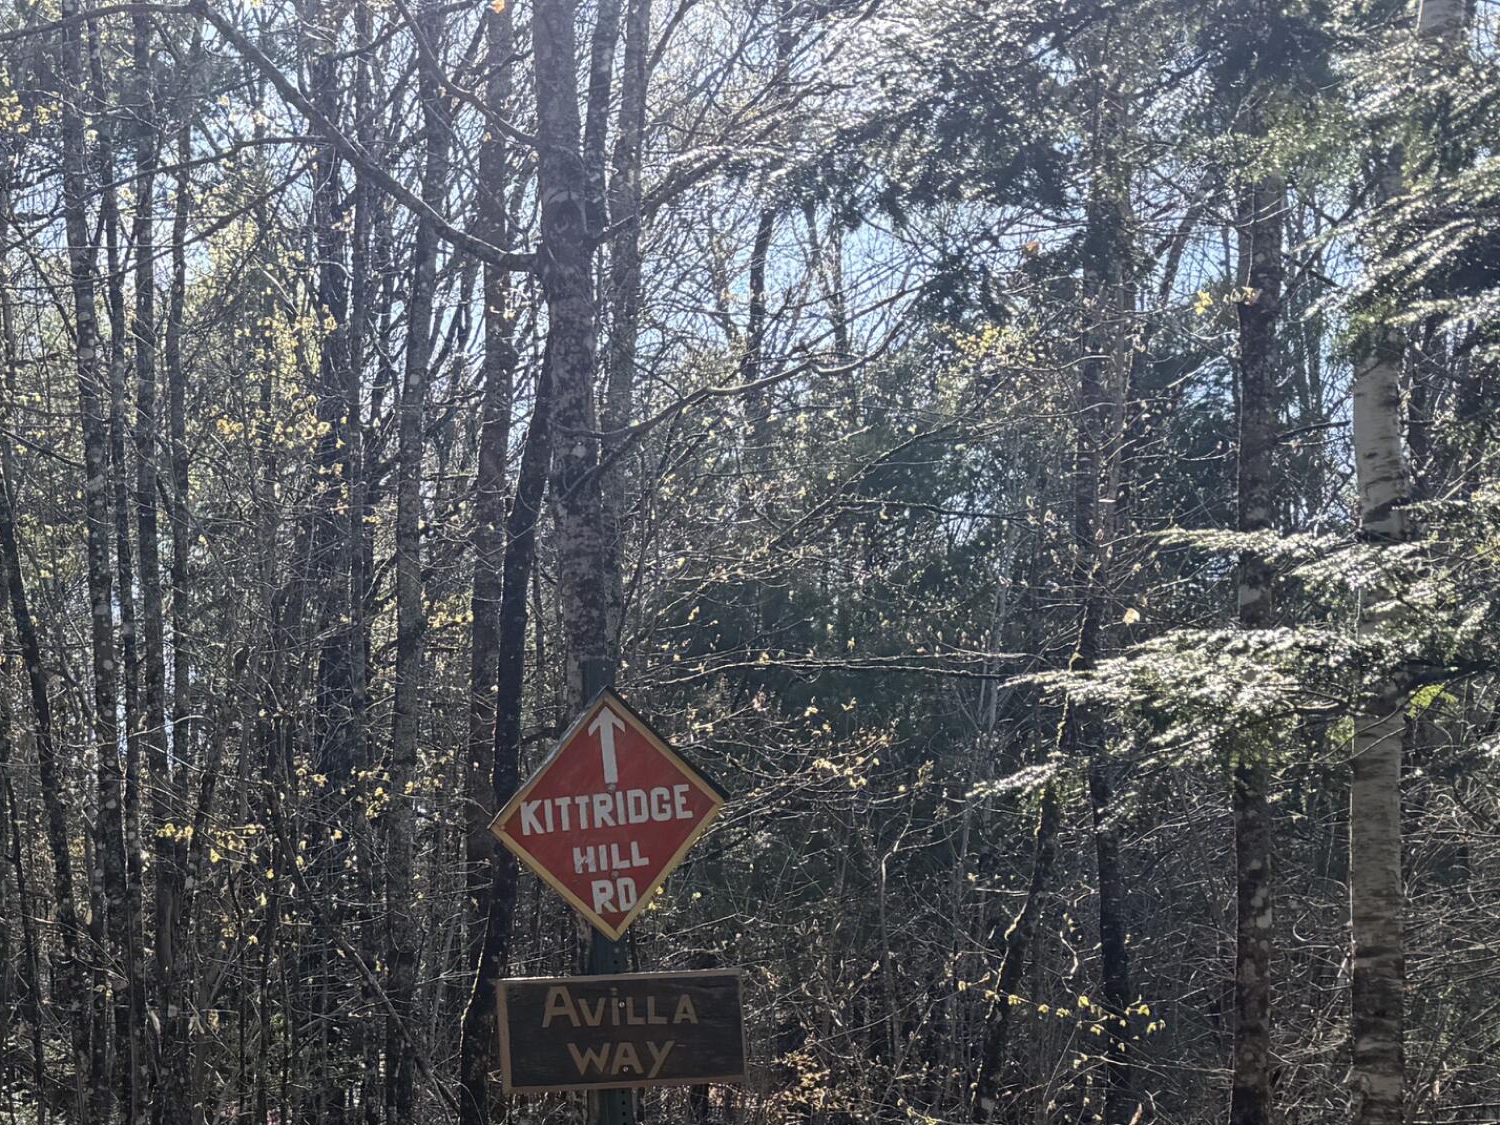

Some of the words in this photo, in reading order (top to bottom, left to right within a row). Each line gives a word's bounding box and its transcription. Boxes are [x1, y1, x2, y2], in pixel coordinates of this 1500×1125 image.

[520, 784, 693, 836] KITTRIDGE
[572, 841, 649, 874] HILL
[591, 877, 638, 914] RD
[567, 1040, 675, 1078] WAY
